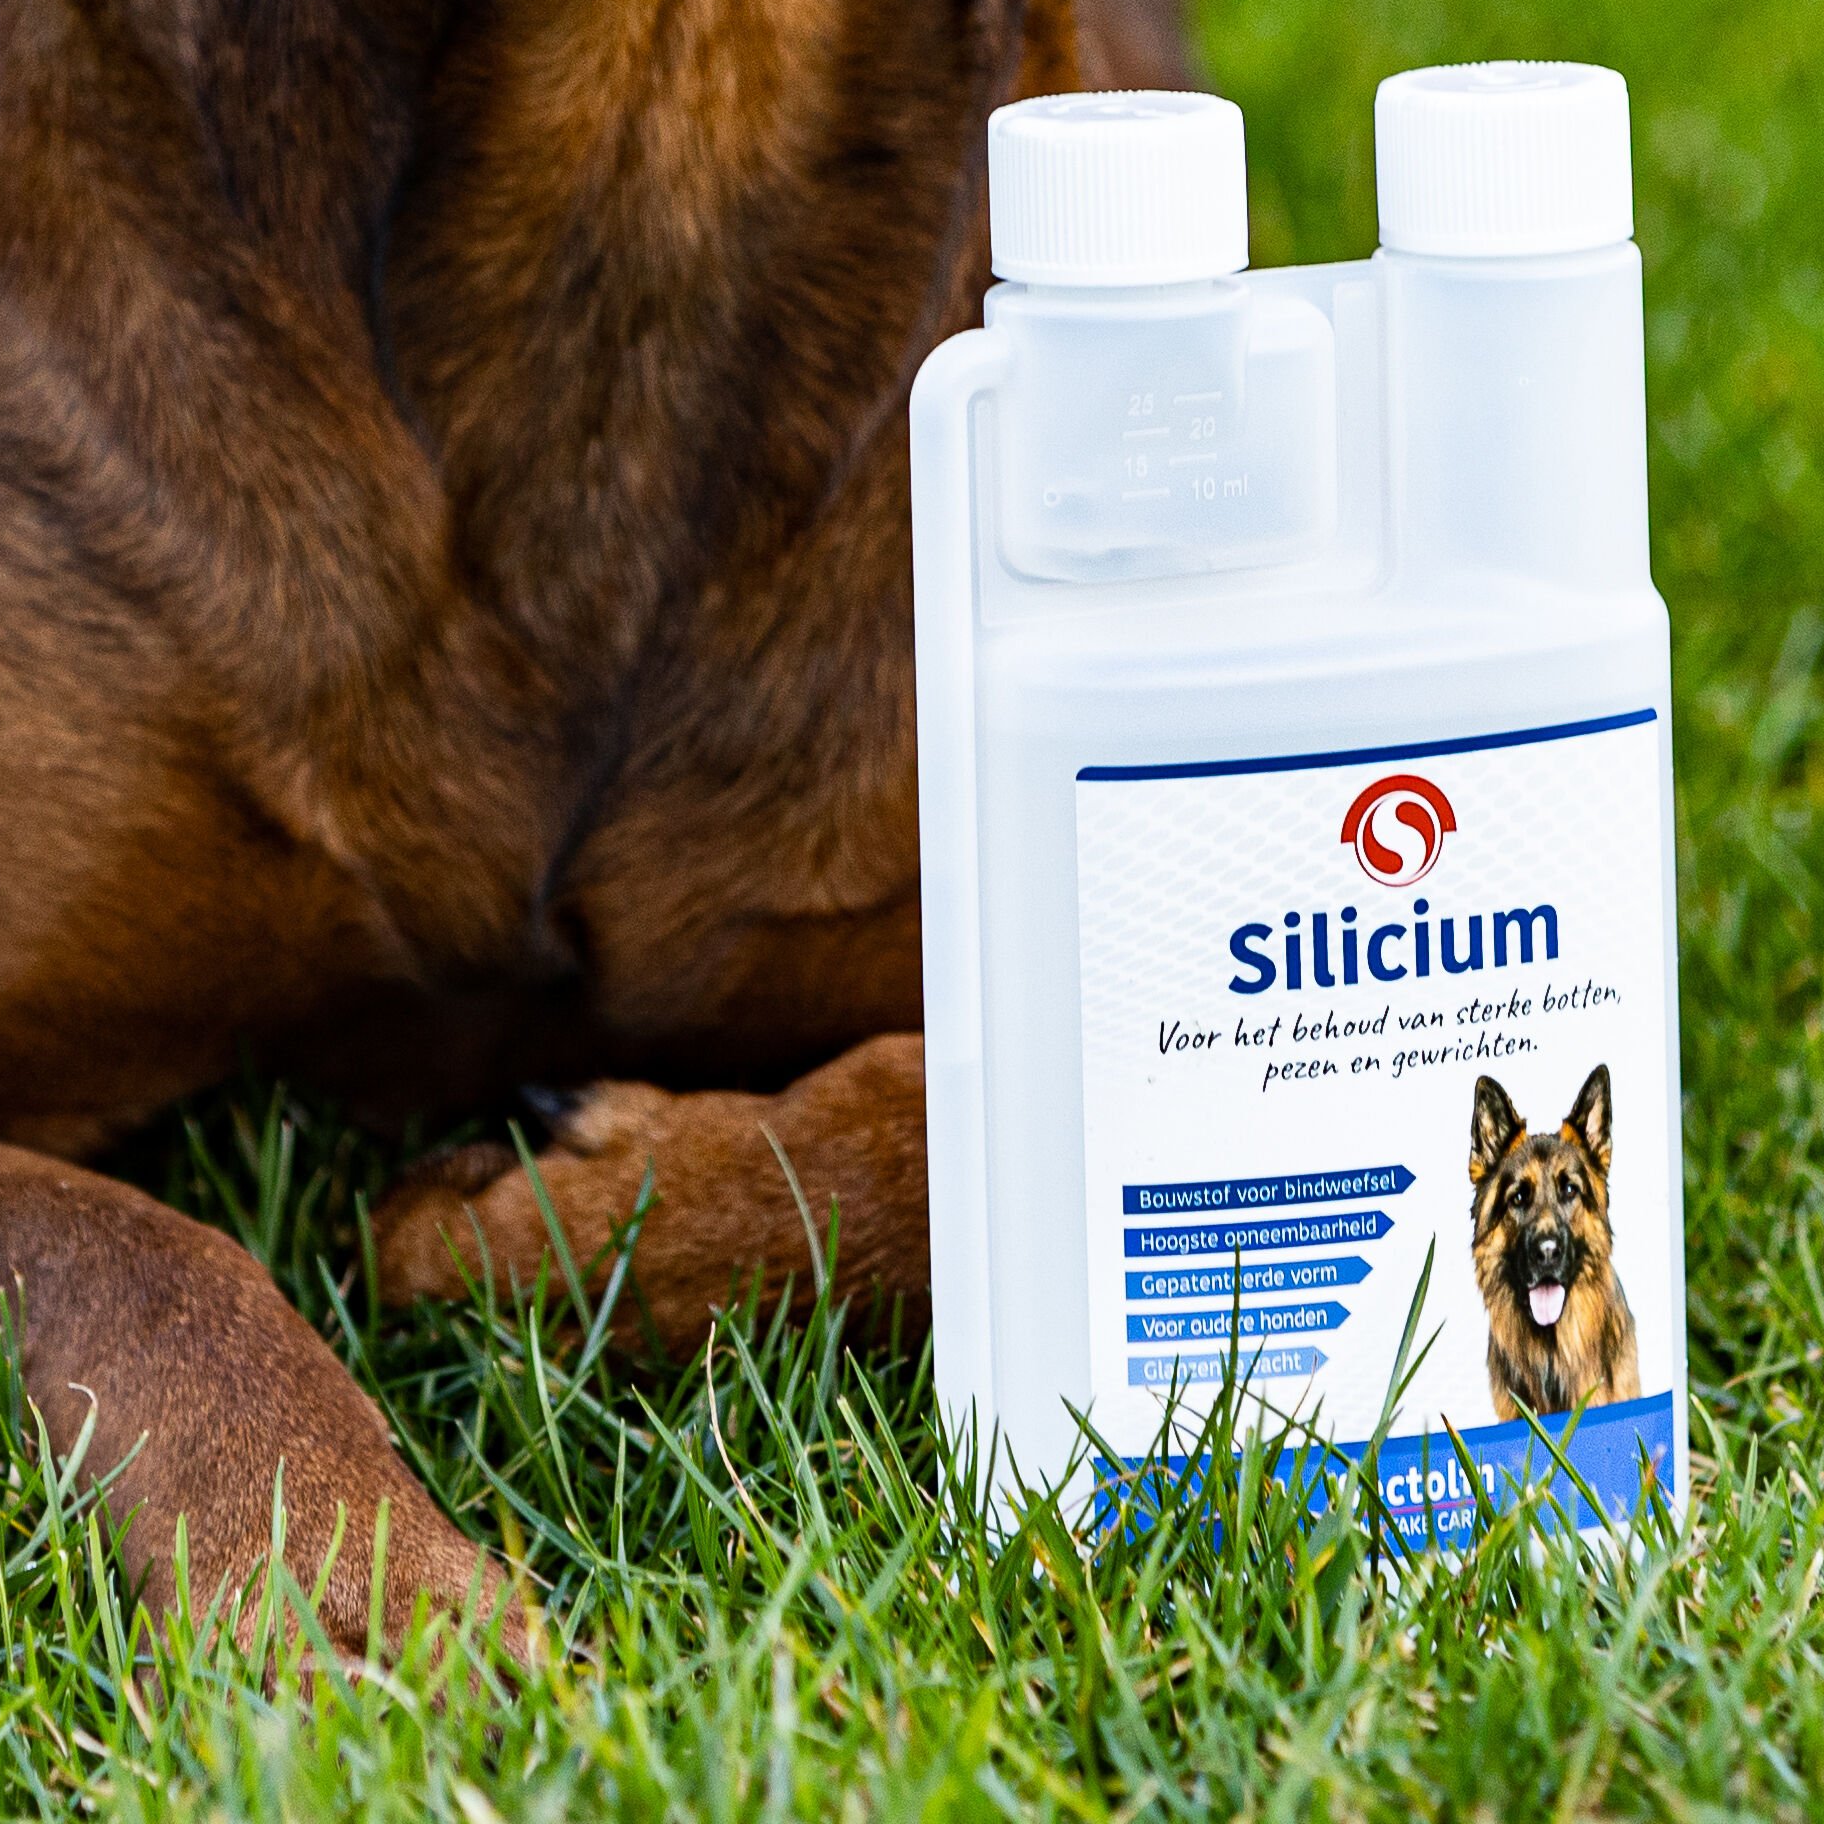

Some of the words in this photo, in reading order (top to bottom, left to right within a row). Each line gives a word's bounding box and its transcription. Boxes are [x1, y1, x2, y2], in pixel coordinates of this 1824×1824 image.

[1127, 393, 1155, 416] 25
[1188, 417, 1216, 440] 20
[1123, 455, 1149, 479] 15
[1191, 477, 1216, 500] 10
[1223, 474, 1248, 497] ml
[1228, 898, 1559, 995] Silicium
[1159, 1020, 1222, 1054] Voor
[1234, 1016, 1282, 1047] het
[1292, 1005, 1390, 1042] behoud
[1399, 1013, 1444, 1031] van
[1456, 988, 1532, 1025] sterke
[1543, 979, 1621, 1012] botten,
[1262, 1060, 1339, 1093] pezen
[1351, 1056, 1380, 1074] en
[1392, 1030, 1538, 1078] gewrichten.
[1139, 1183, 1231, 1209] Bouwstof
[1237, 1185, 1278, 1203] voor
[1284, 1169, 1396, 1200] bindweefsel
[1140, 1231, 1219, 1255] Hoogste
[1224, 1214, 1377, 1247] opneembaarheid
[1290, 1264, 1338, 1285] vorm
[1141, 1318, 1186, 1338] Voor
[1190, 1311, 1255, 1334] oudere
[1259, 1306, 1328, 1330] honden
[1143, 1356, 1245, 1382] Glanzene
[1249, 1352, 1302, 1376] vacht
